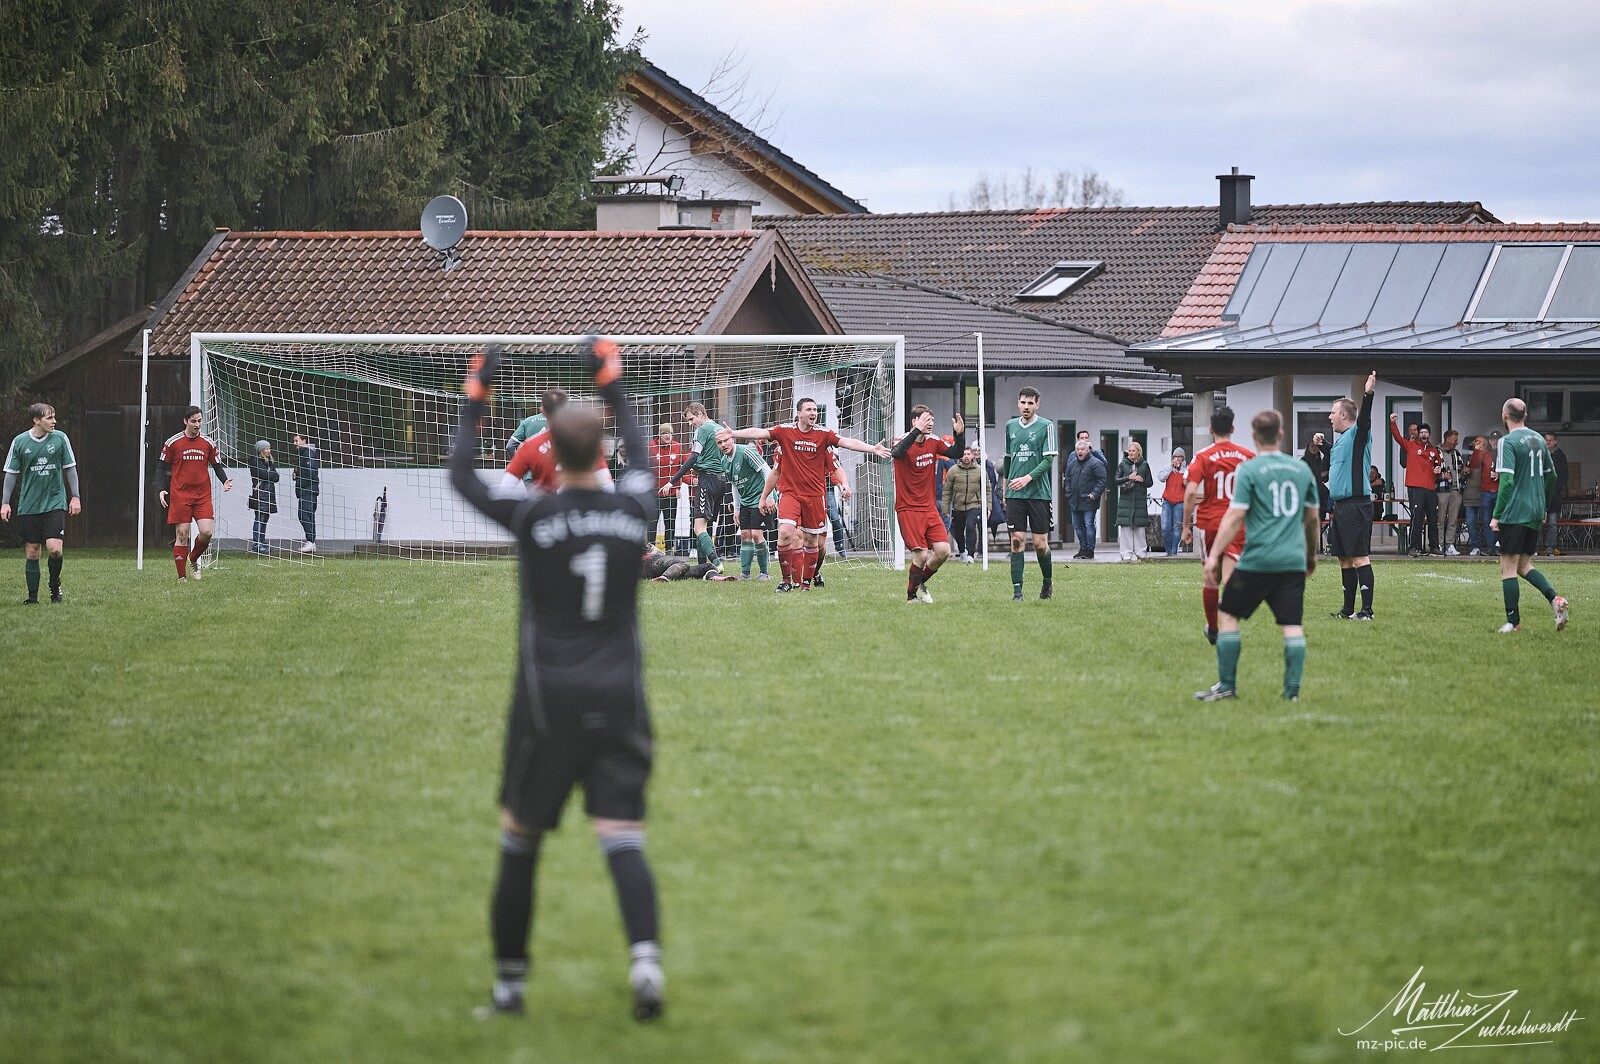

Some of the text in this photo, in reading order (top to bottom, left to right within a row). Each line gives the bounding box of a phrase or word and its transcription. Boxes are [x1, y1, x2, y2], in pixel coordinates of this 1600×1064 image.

[1528, 449, 1544, 477] 11
[1213, 470, 1236, 500] 10
[1268, 479, 1300, 518] 10
[568, 543, 608, 621] 1
